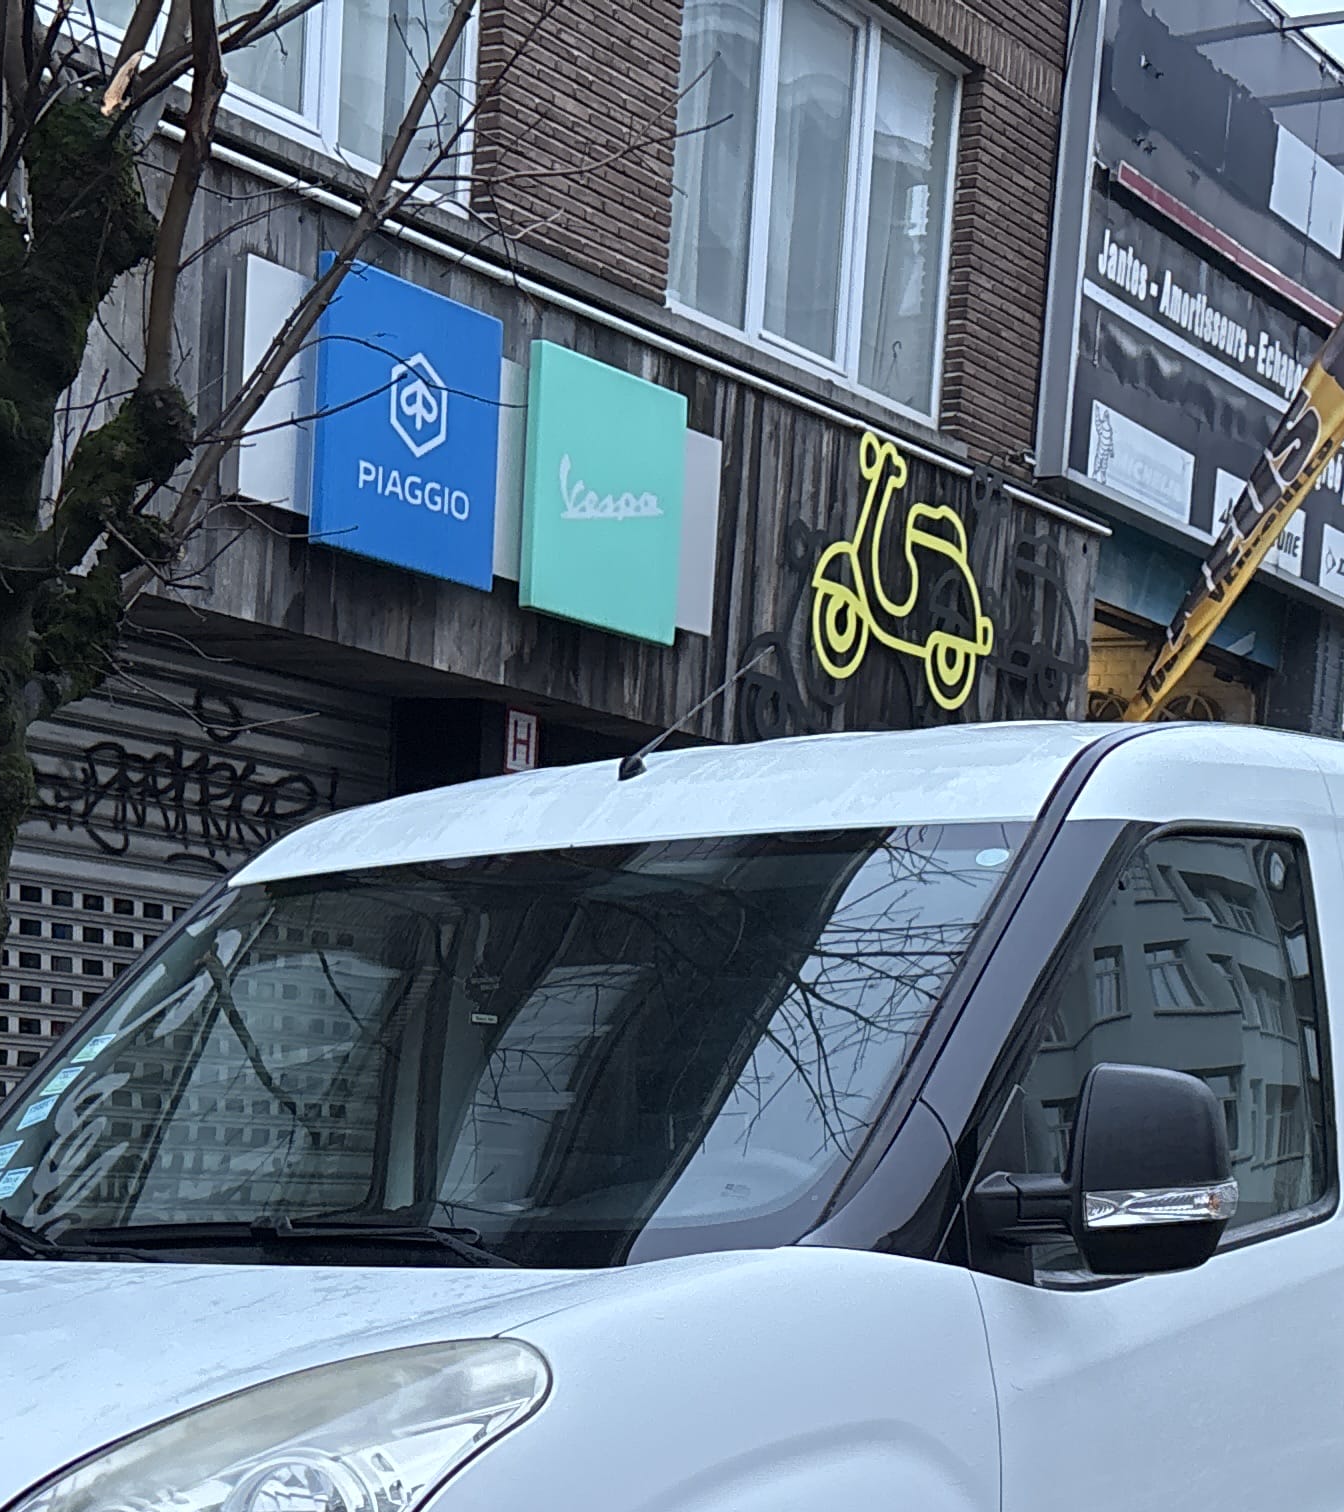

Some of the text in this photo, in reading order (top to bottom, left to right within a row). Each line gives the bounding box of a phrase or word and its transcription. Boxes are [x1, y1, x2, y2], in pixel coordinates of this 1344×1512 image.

[1098, 229, 1147, 300] Jantes
[1159, 269, 1247, 363] Amortisseurs
[1256, 331, 1308, 400] Echapp
[358, 460, 470, 521] PIAGGIO
[559, 453, 664, 520] Vespa
[512, 719, 532, 765] H
